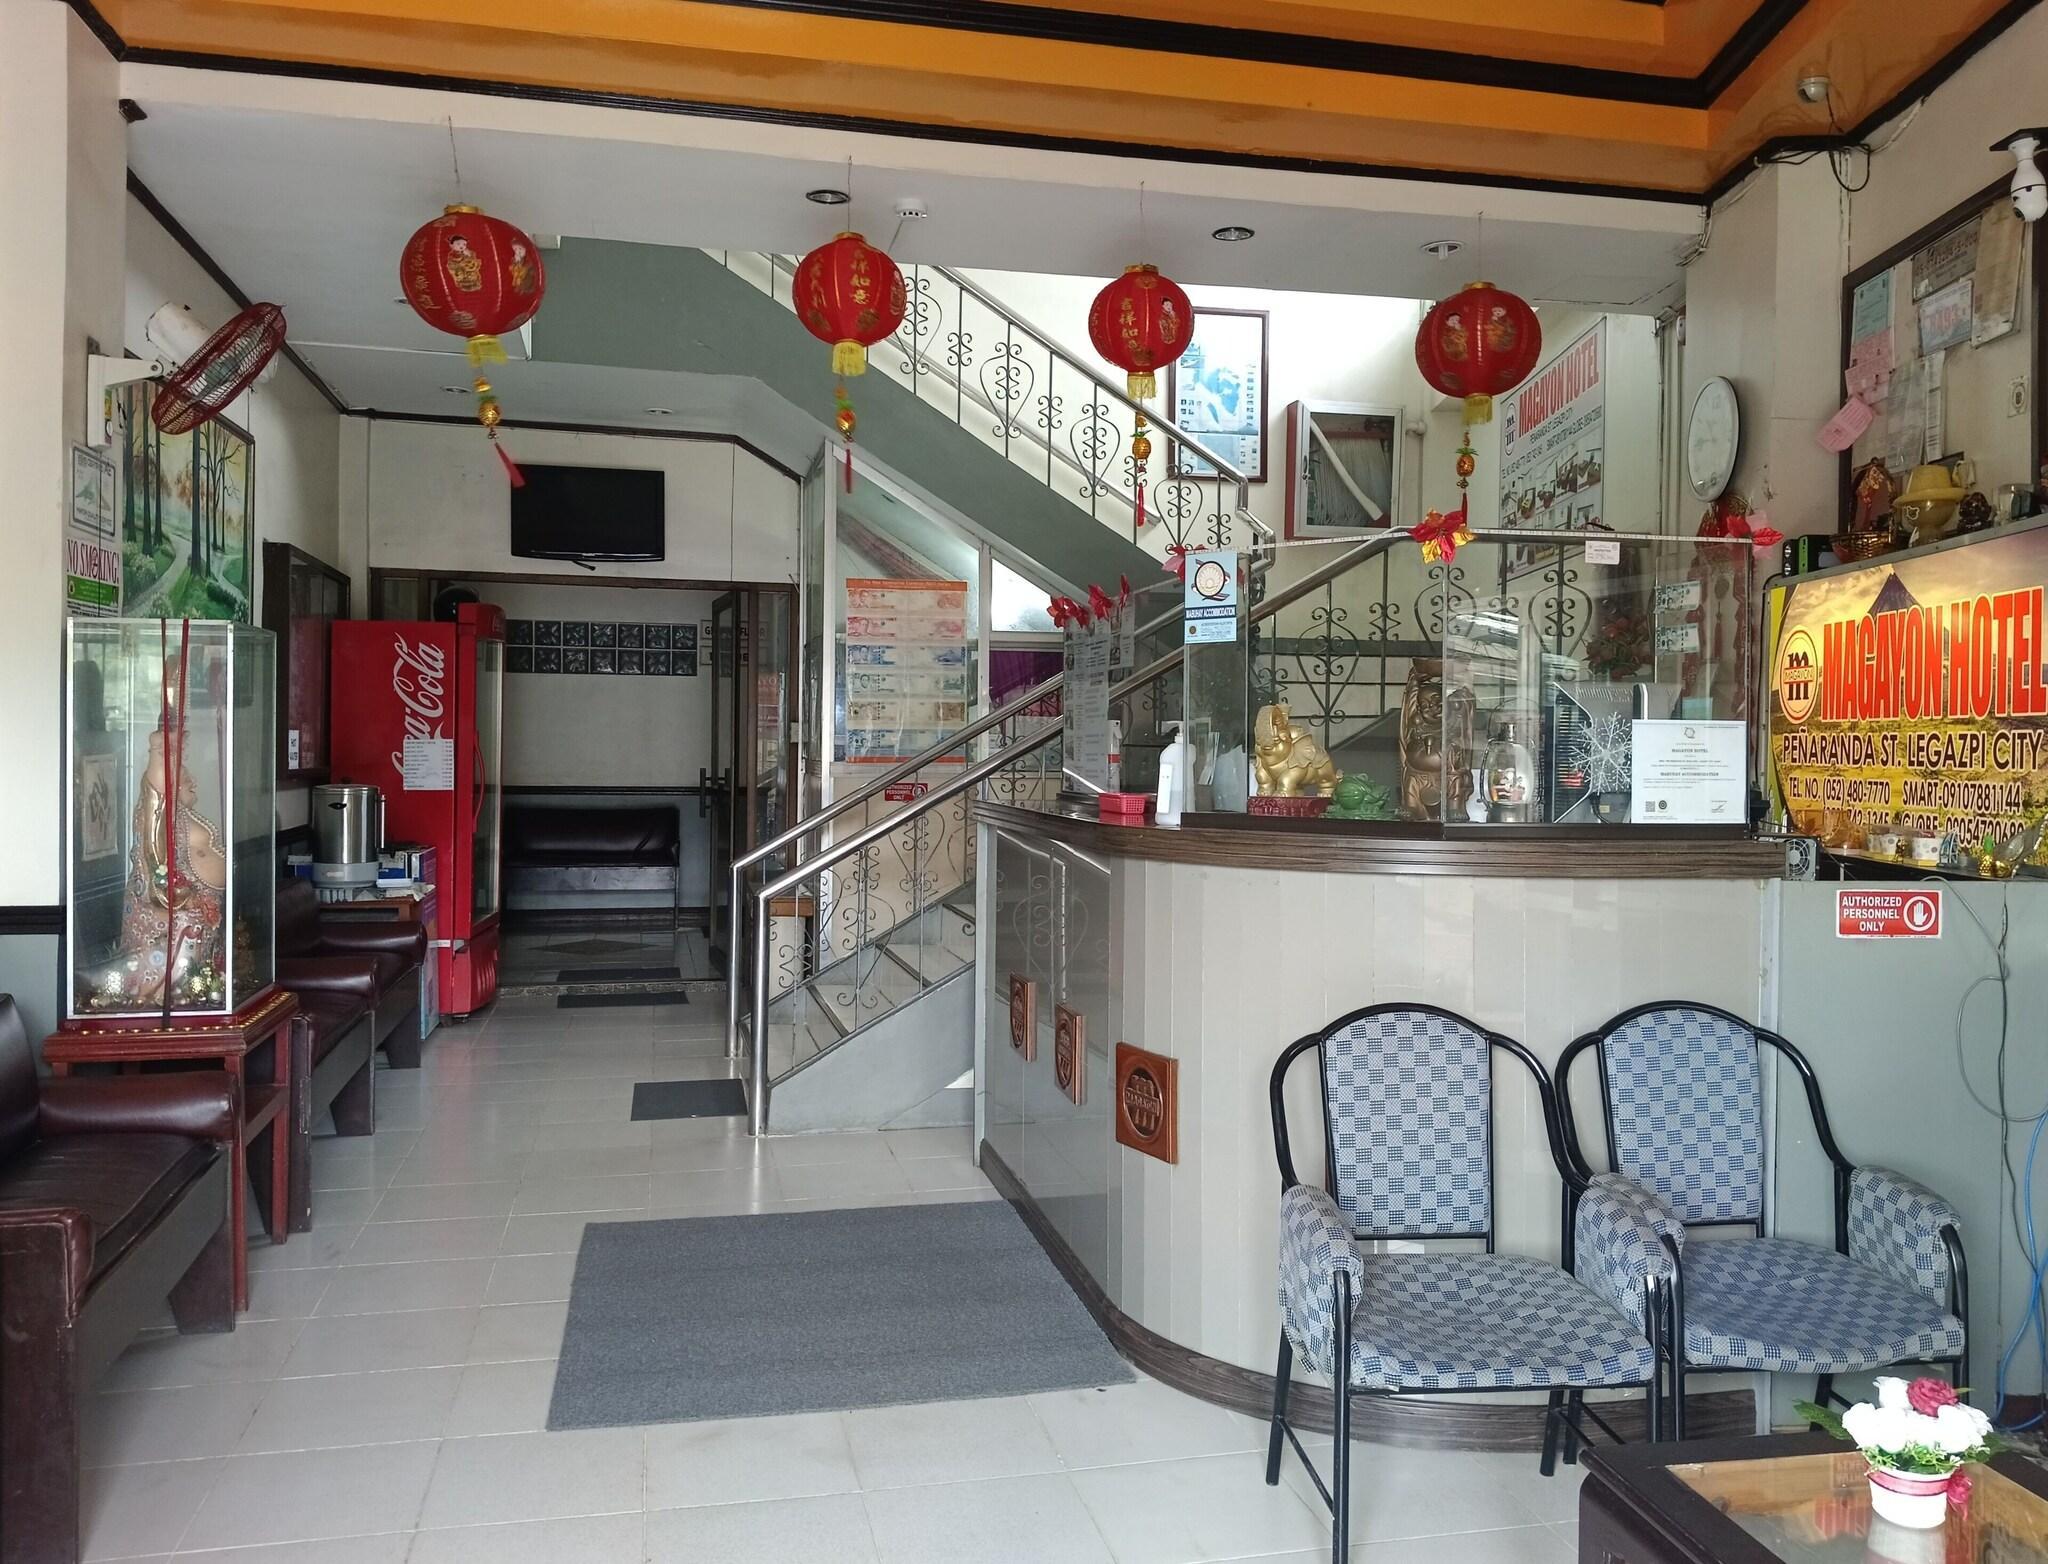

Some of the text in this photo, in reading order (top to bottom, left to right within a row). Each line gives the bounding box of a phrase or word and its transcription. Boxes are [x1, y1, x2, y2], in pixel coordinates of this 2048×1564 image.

[1519, 360, 1565, 438] MAGAYON
[1566, 332, 1599, 404] HOTEL
[66, 538, 78, 575] NO
[1821, 588, 2047, 721] MAGAYON HOTEL
[1783, 727, 2044, 770] PEÑARANDA ST. LEGAZPI CITY
[1789, 777, 1890, 806] TEL. NO. (052) 480-7770
[1842, 896, 1902, 907] AUTHORIZED
[1843, 908, 1900, 919] PERSONNEL
[1859, 921, 1885, 932] ONLY
